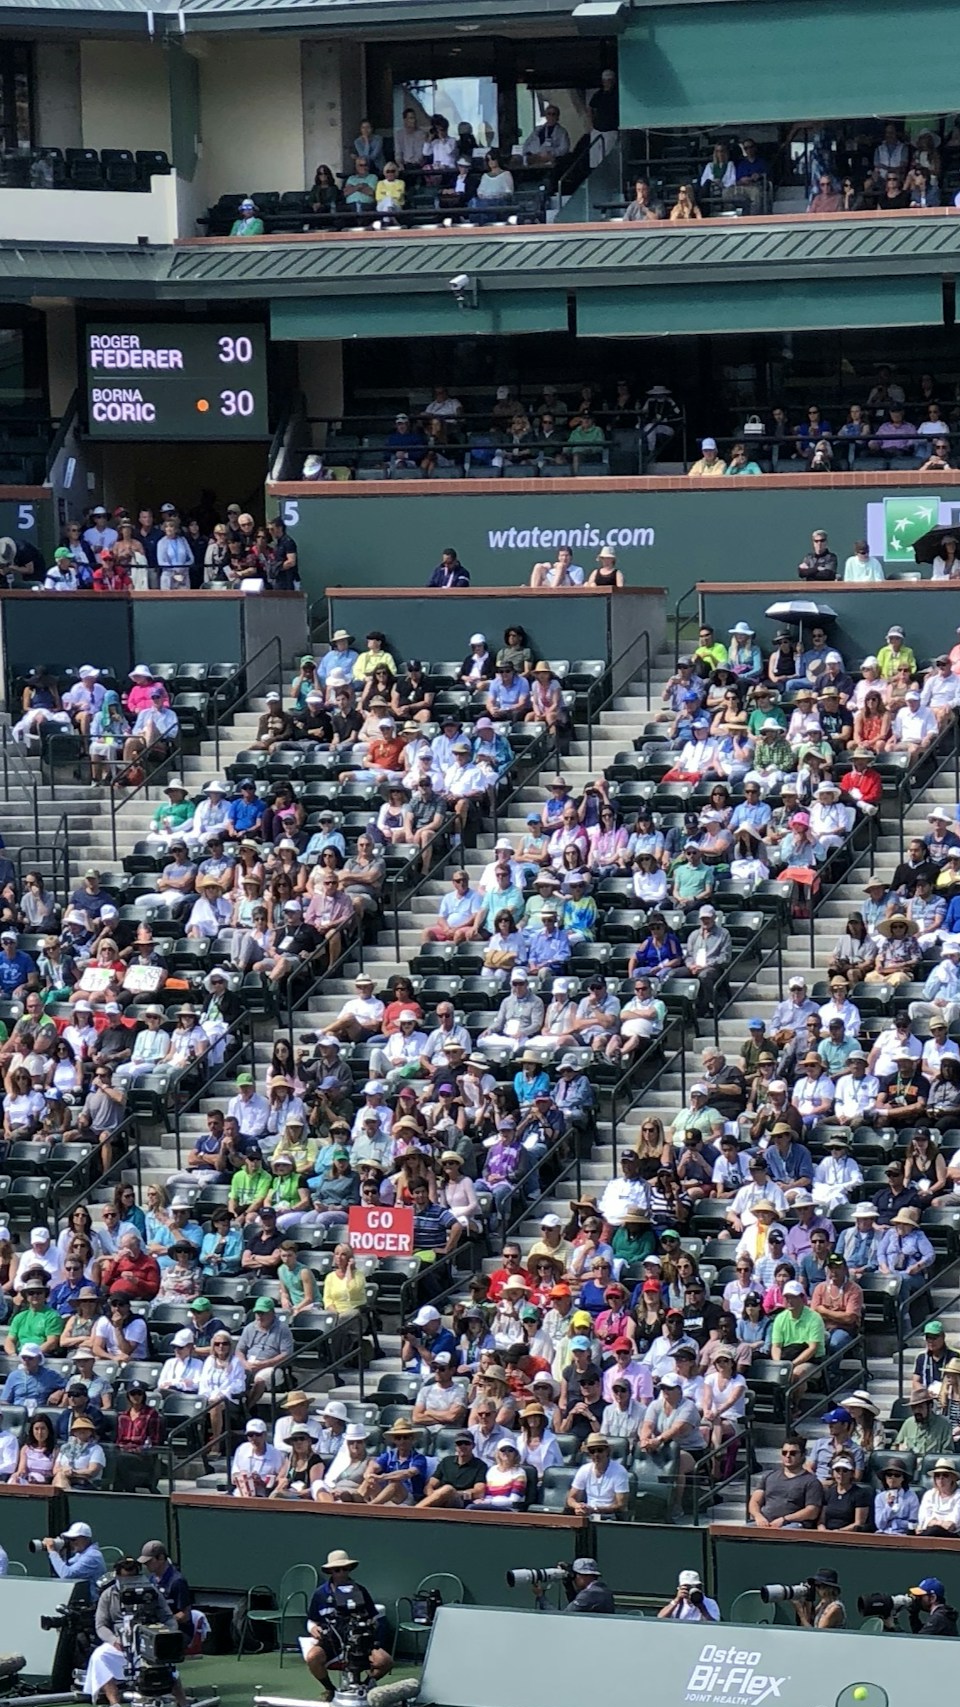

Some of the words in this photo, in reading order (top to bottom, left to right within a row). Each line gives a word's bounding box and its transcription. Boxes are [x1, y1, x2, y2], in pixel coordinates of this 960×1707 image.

[90, 335, 140, 349] ROGER
[217, 336, 253, 362] 30
[91, 349, 184, 369] FEDERER
[92, 388, 143, 402] BORNA
[220, 390, 254, 416] 30
[92, 402, 156, 422] CORIC
[17, 504, 35, 530] 5
[283, 500, 300, 527] 5
[488, 522, 656, 549] wtatennis.com
[367, 1210, 393, 1229] GO
[349, 1231, 411, 1252] ROGER
[698, 1644, 762, 1666] Osteo
[686, 1664, 787, 1706] Bi-Flex
[685, 1693, 712, 1703] JOINT
